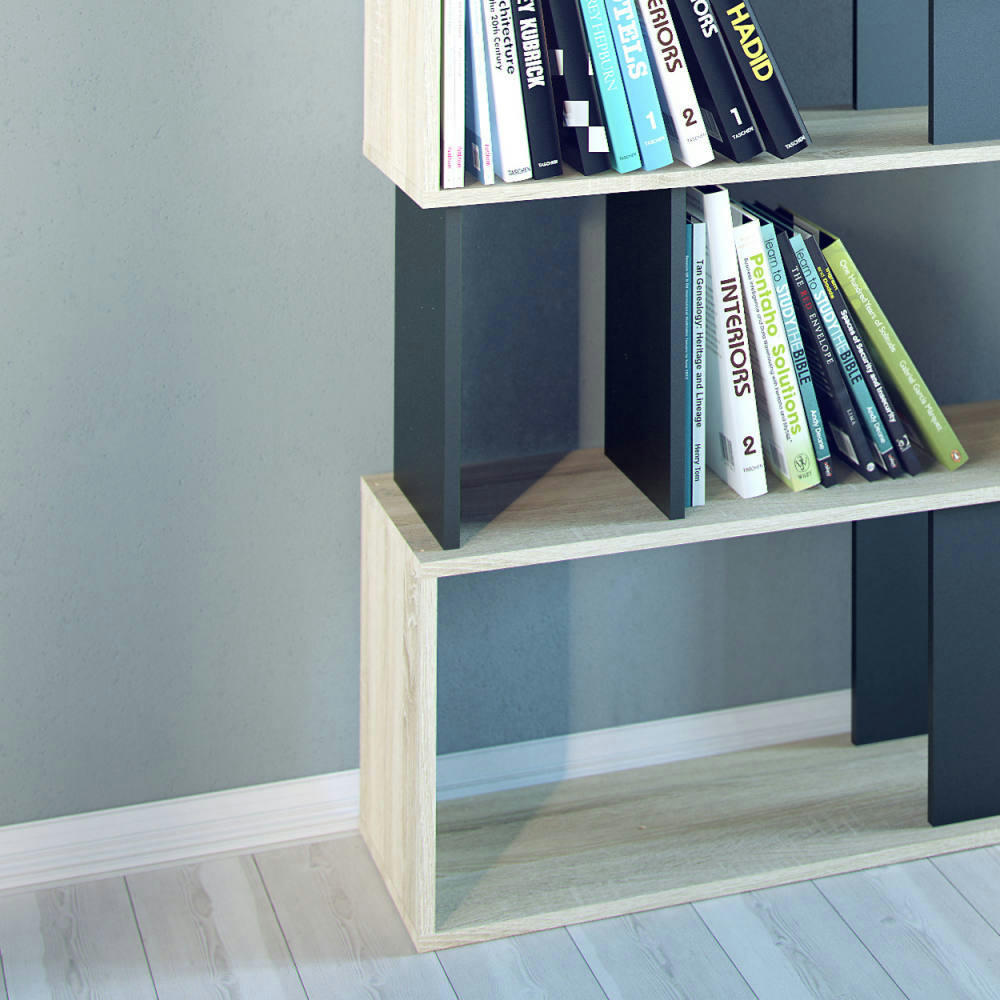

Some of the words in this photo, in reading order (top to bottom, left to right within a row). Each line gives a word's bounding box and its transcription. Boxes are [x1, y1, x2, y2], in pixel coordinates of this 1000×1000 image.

[491, 14, 501, 32] 20th
[494, 36, 502, 71] Century
[520, 17, 546, 90] KUBRICK
[726, 1, 774, 82] HADID
[645, 111, 657, 130] 1
[682, 107, 697, 127] 2
[729, 107, 743, 126] 1
[732, 126, 754, 140] TASCHEN
[695, 259, 704, 276] Tan
[764, 238, 778, 268] learn
[772, 269, 782, 282] to
[796, 248, 811, 278] learn
[808, 277, 817, 290] to
[694, 277, 704, 329] Genealogy:
[791, 266, 804, 288] THE
[800, 289, 813, 310] RED
[809, 312, 834, 365] ENVELOPE
[720, 277, 751, 397] INTERIORS
[840, 309, 855, 336] Spaces
[852, 334, 862, 344] of
[694, 331, 704, 370] Heritage
[750, 252, 777, 337] Pentaho
[772, 343, 801, 435] Solutions
[856, 342, 873, 374] Security
[696, 372, 704, 389] and
[694, 391, 704, 428] Lineage
[876, 386, 897, 422] Insecurity
[693, 443, 701, 465] Henry
[742, 435, 757, 456] 2
